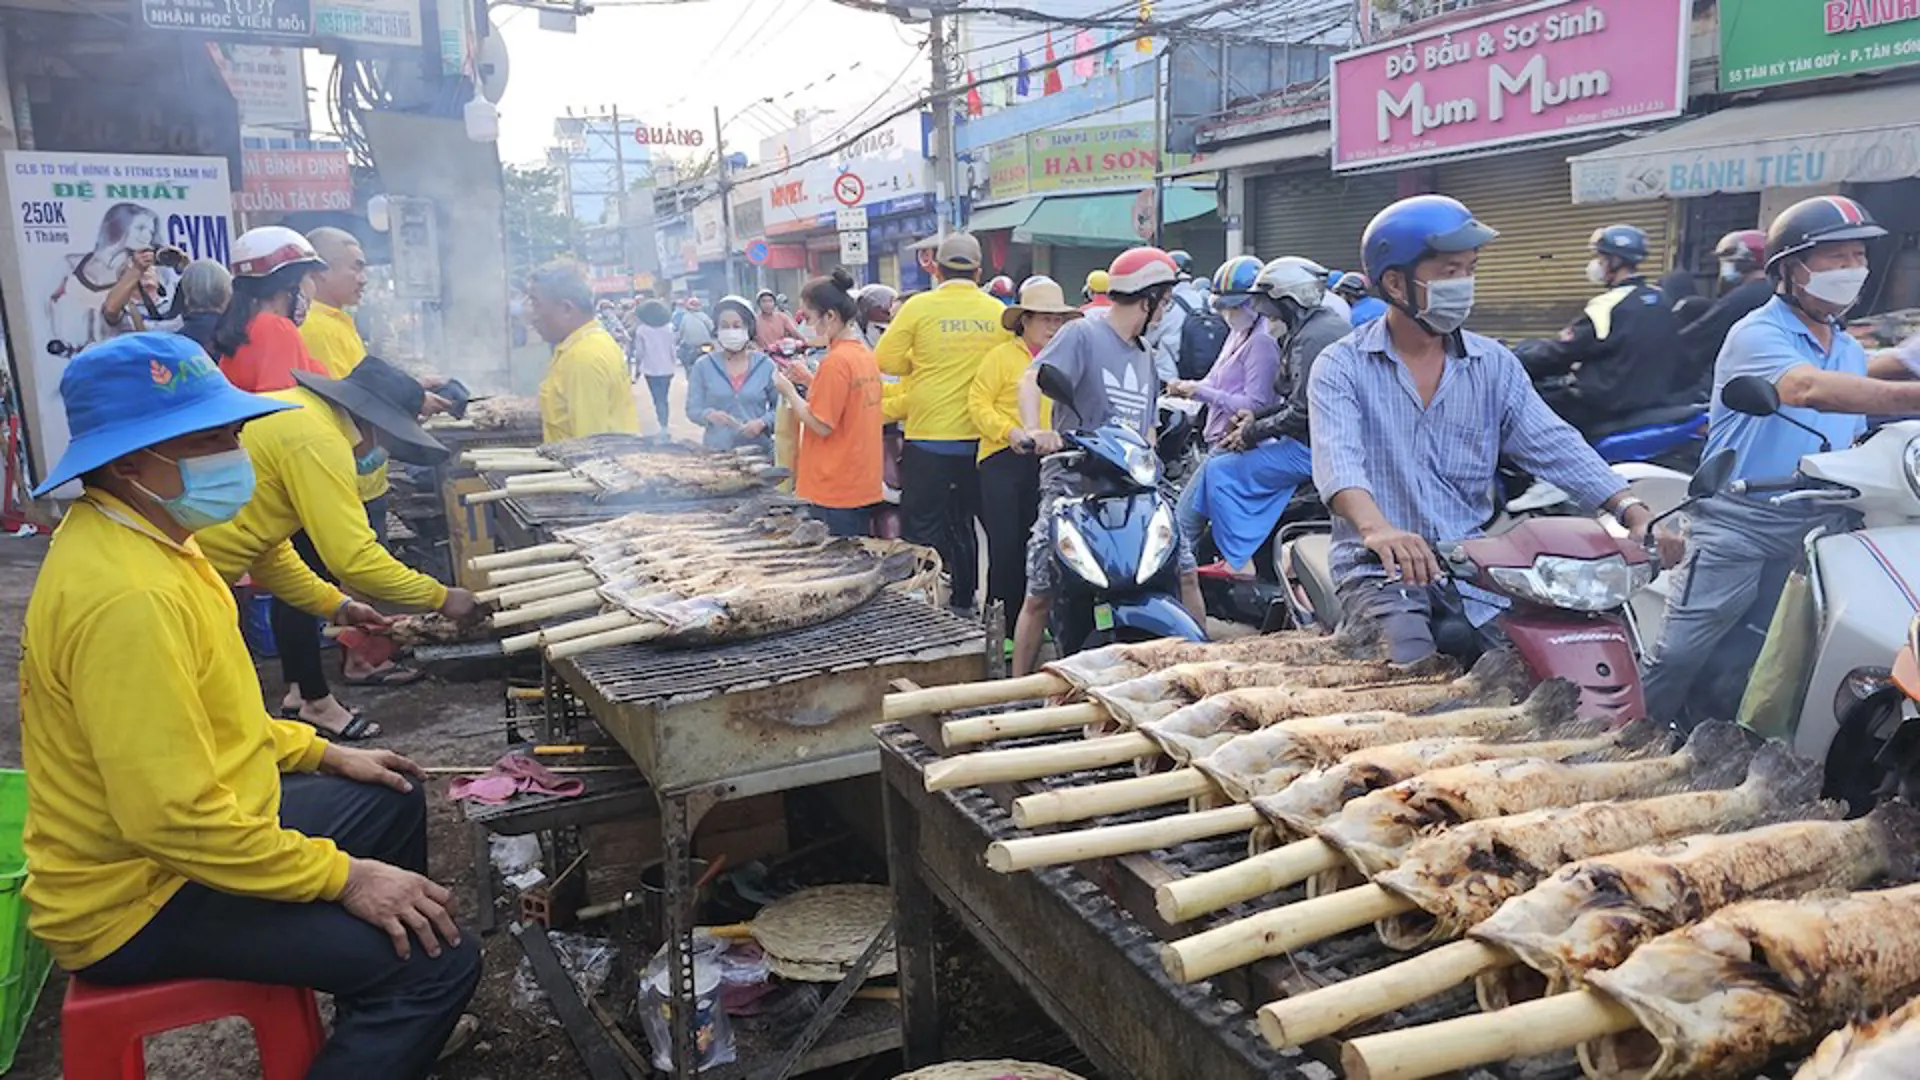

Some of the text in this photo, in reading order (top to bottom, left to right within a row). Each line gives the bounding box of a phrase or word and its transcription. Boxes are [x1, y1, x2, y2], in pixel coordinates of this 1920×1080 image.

[151, 8, 195, 26] NHẬN
[201, 13, 232, 28] HỌC
[1385, 5, 1605, 79] Đồ Bầu & Sơ Sinh
[1745, 64, 1767, 79] TÂN
[1788, 58, 1812, 73] TÂN
[1851, 50, 1863, 63] P.
[1864, 44, 1891, 61] TÂN
[1377, 54, 1611, 142] Mum Mum
[1103, 147, 1157, 171] SƠN
[1669, 152, 1746, 191] BÁNH
[1755, 146, 1826, 185] TIÊU
[113, 166, 122, 177] &
[125, 166, 171, 178] FITNESS
[173, 167, 199, 179] NAM
[53, 180, 190, 202] ĐỆ NHẤT
[21, 201, 66, 224] 250K
[25, 230, 69, 245] 1 Tháng
[167, 213, 230, 268] GYM
[939, 319, 995, 333] TRUNG
